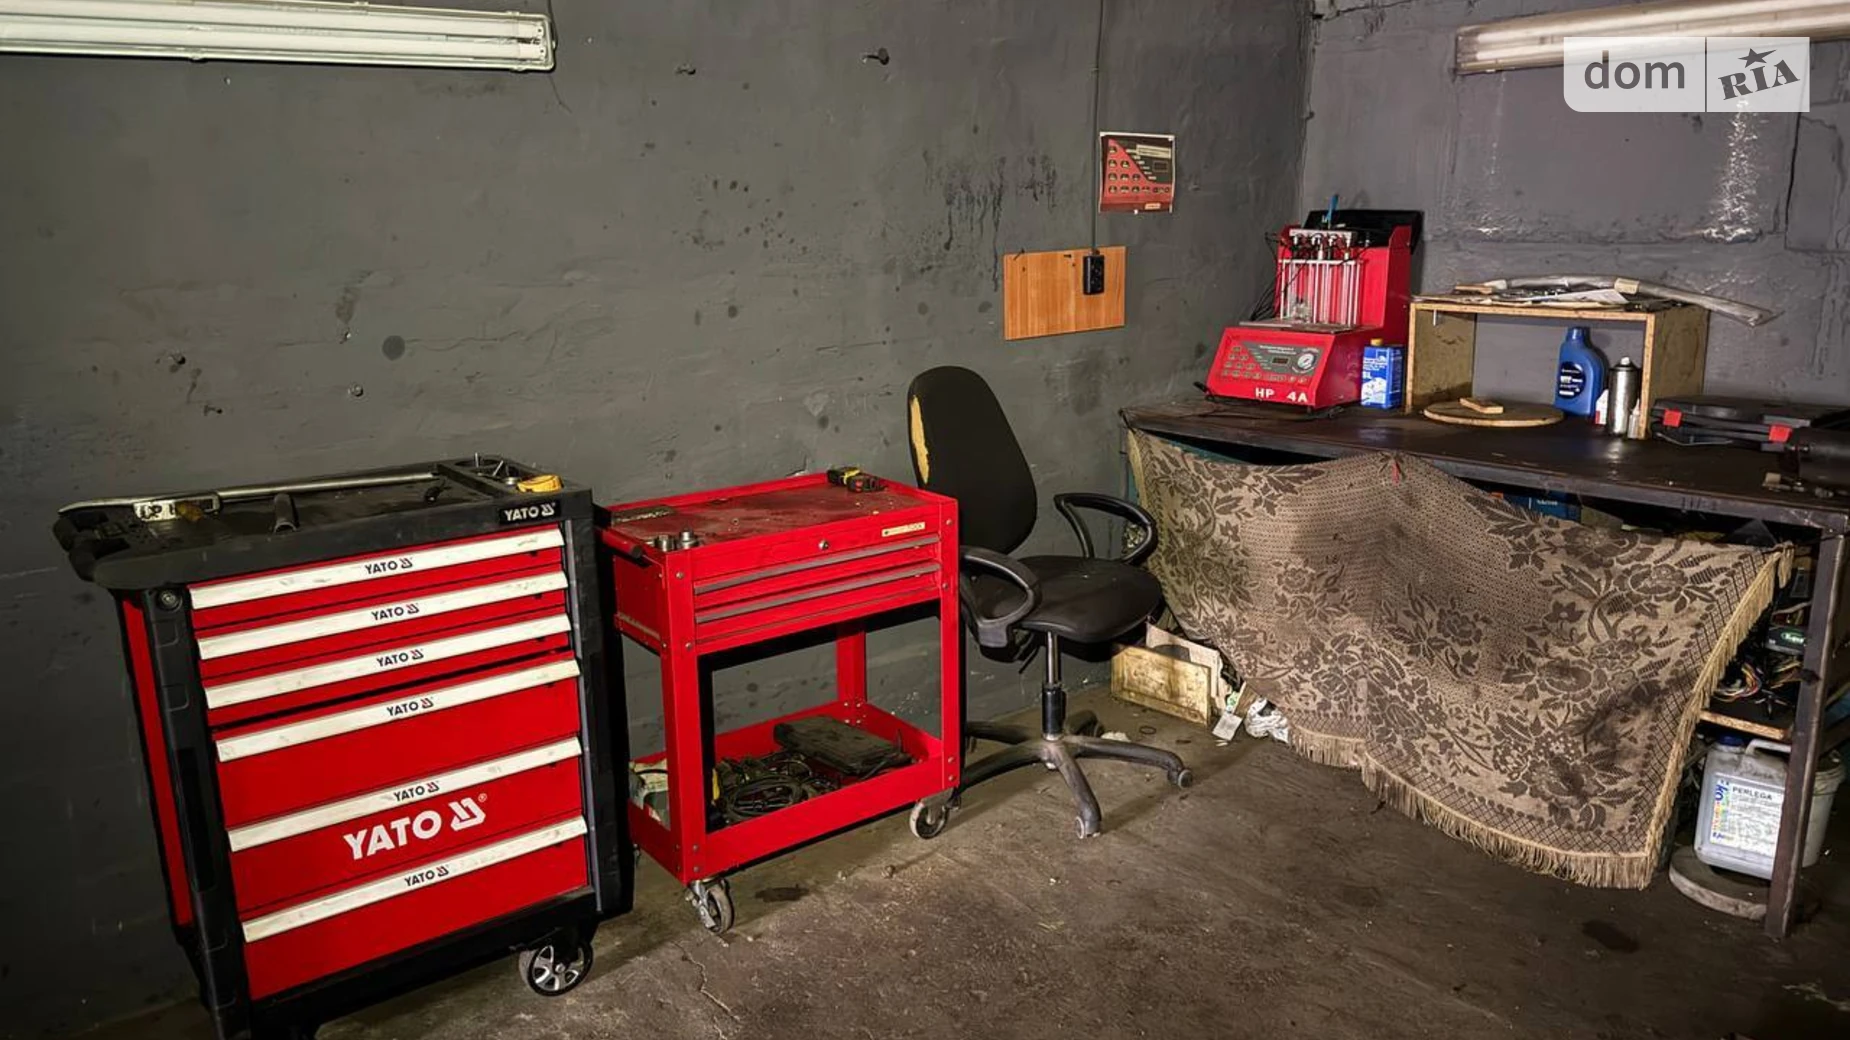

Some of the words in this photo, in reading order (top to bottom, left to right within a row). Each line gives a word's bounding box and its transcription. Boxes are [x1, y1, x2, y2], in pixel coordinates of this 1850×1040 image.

[1255, 387, 1275, 399] HP
[1286, 390, 1308, 402] 4A
[504, 506, 539, 522] YATO
[365, 559, 398, 575] YATO
[371, 606, 404, 621] YATO
[376, 652, 409, 668] YATO
[387, 701, 419, 717] YATO
[393, 785, 426, 802] YATO
[343, 809, 442, 861] YATO
[404, 870, 436, 887] YATO
